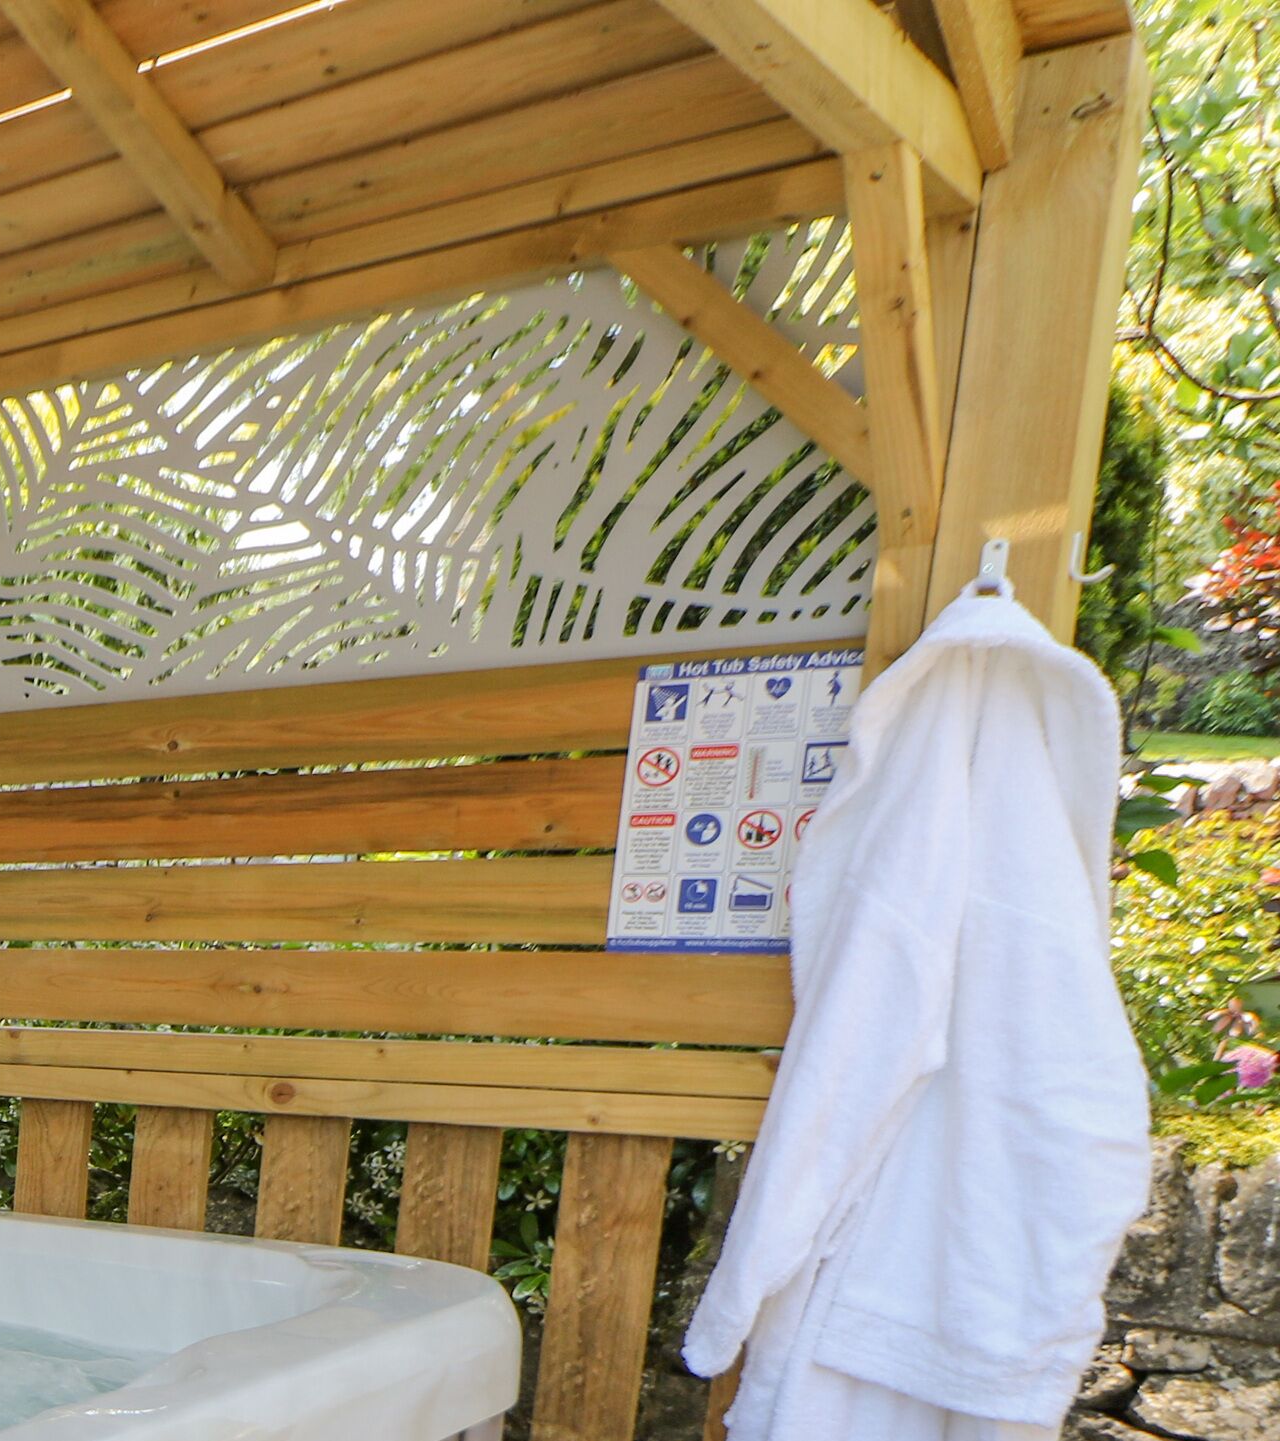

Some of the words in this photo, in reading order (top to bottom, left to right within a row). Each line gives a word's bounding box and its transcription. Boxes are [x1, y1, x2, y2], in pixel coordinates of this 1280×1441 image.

[678, 659, 709, 677] Hot
[712, 657, 744, 674] Tub
[747, 653, 804, 672] Safety
[805, 649, 864, 667] Advice
[631, 815, 674, 826] CAUTION
